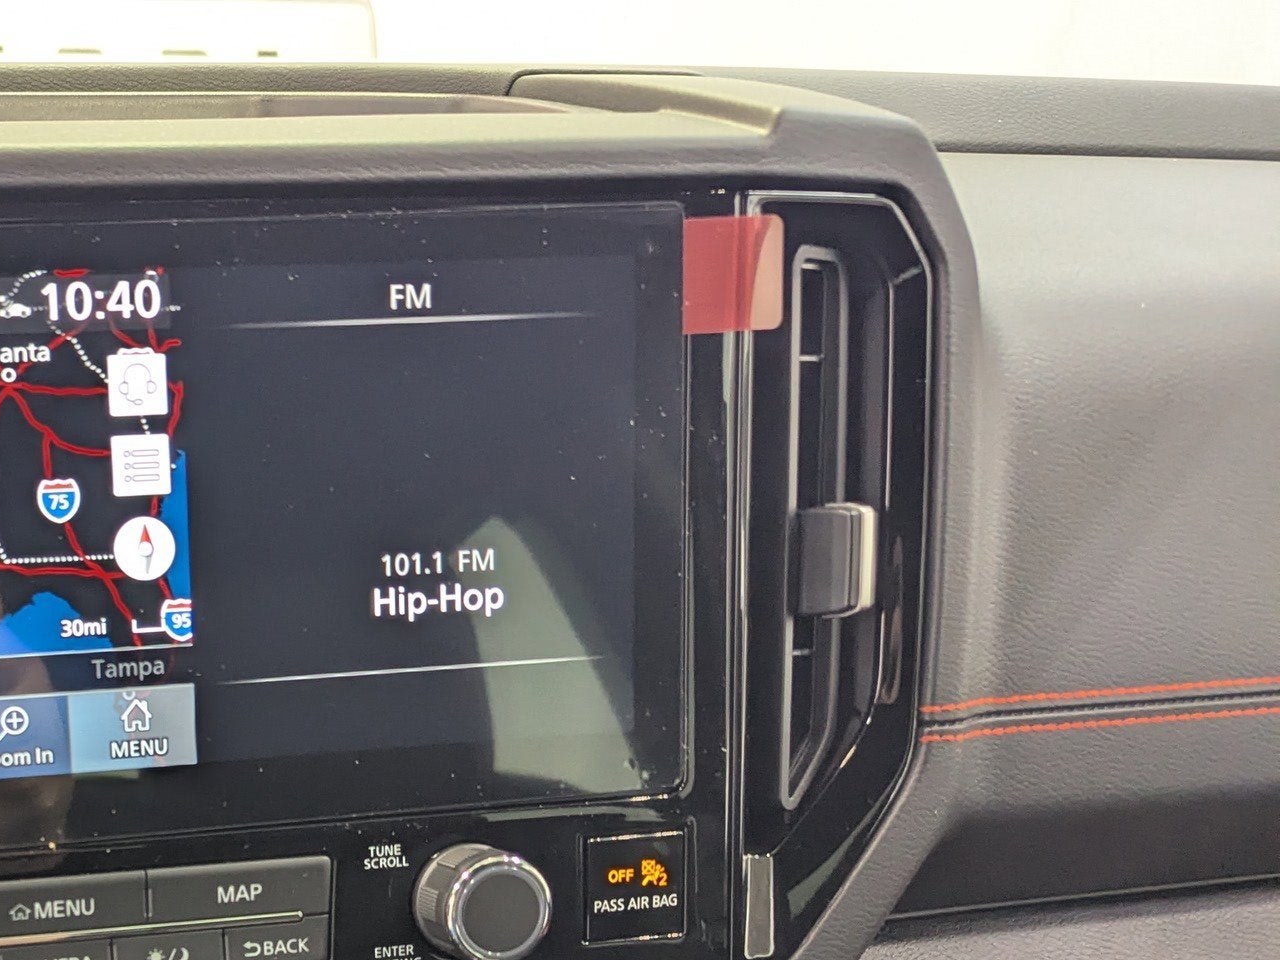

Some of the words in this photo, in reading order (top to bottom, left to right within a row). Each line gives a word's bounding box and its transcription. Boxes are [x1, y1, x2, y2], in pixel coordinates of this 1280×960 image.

[41, 280, 161, 321] 10:40
[389, 283, 432, 310] FM
[48, 494, 69, 510] 75
[381, 552, 442, 576] 101.1
[458, 548, 495, 572] FM
[373, 583, 504, 621] Hip-Hop
[60, 618, 106, 638] 30mi
[171, 612, 192, 629] 95
[92, 658, 165, 682] Tampa
[35, 748, 54, 766] In
[110, 738, 168, 759] MENU
[368, 844, 402, 858] TUNE
[364, 855, 410, 870] SCROLL
[608, 868, 634, 884] OFF
[217, 883, 262, 904] MAP
[594, 898, 624, 914] PASS
[628, 896, 650, 910] AIR
[652, 893, 678, 908] BAG
[34, 898, 96, 920] MENU
[263, 937, 310, 956] BACK
[374, 944, 414, 959] ENTER
